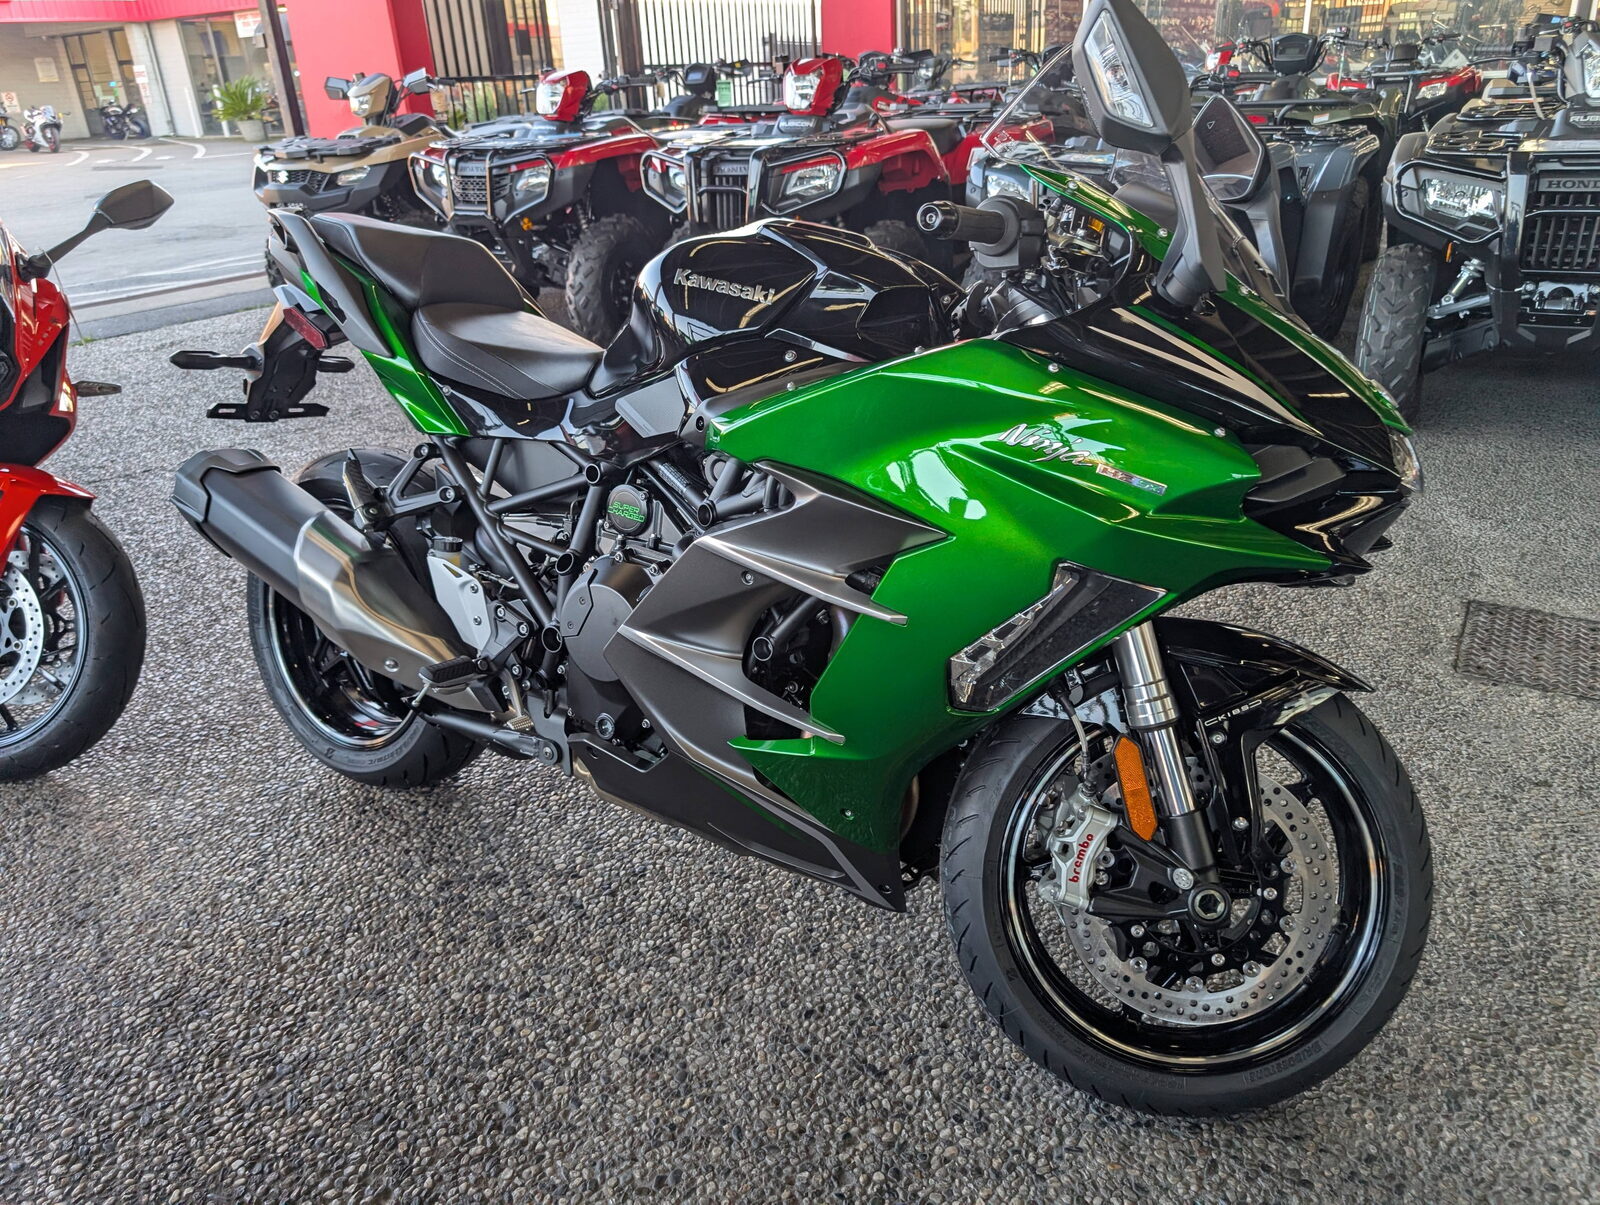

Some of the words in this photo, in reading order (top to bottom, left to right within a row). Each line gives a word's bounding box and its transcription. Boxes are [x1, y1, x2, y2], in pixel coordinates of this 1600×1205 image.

[673, 268, 776, 305] Kawasaki
[997, 423, 1094, 467] Ninja
[608, 505, 645, 522] CHARGED
[612, 501, 640, 513] SUPER
[1217, 704, 1250, 722] KIBS
[1069, 833, 1094, 883] brembo
